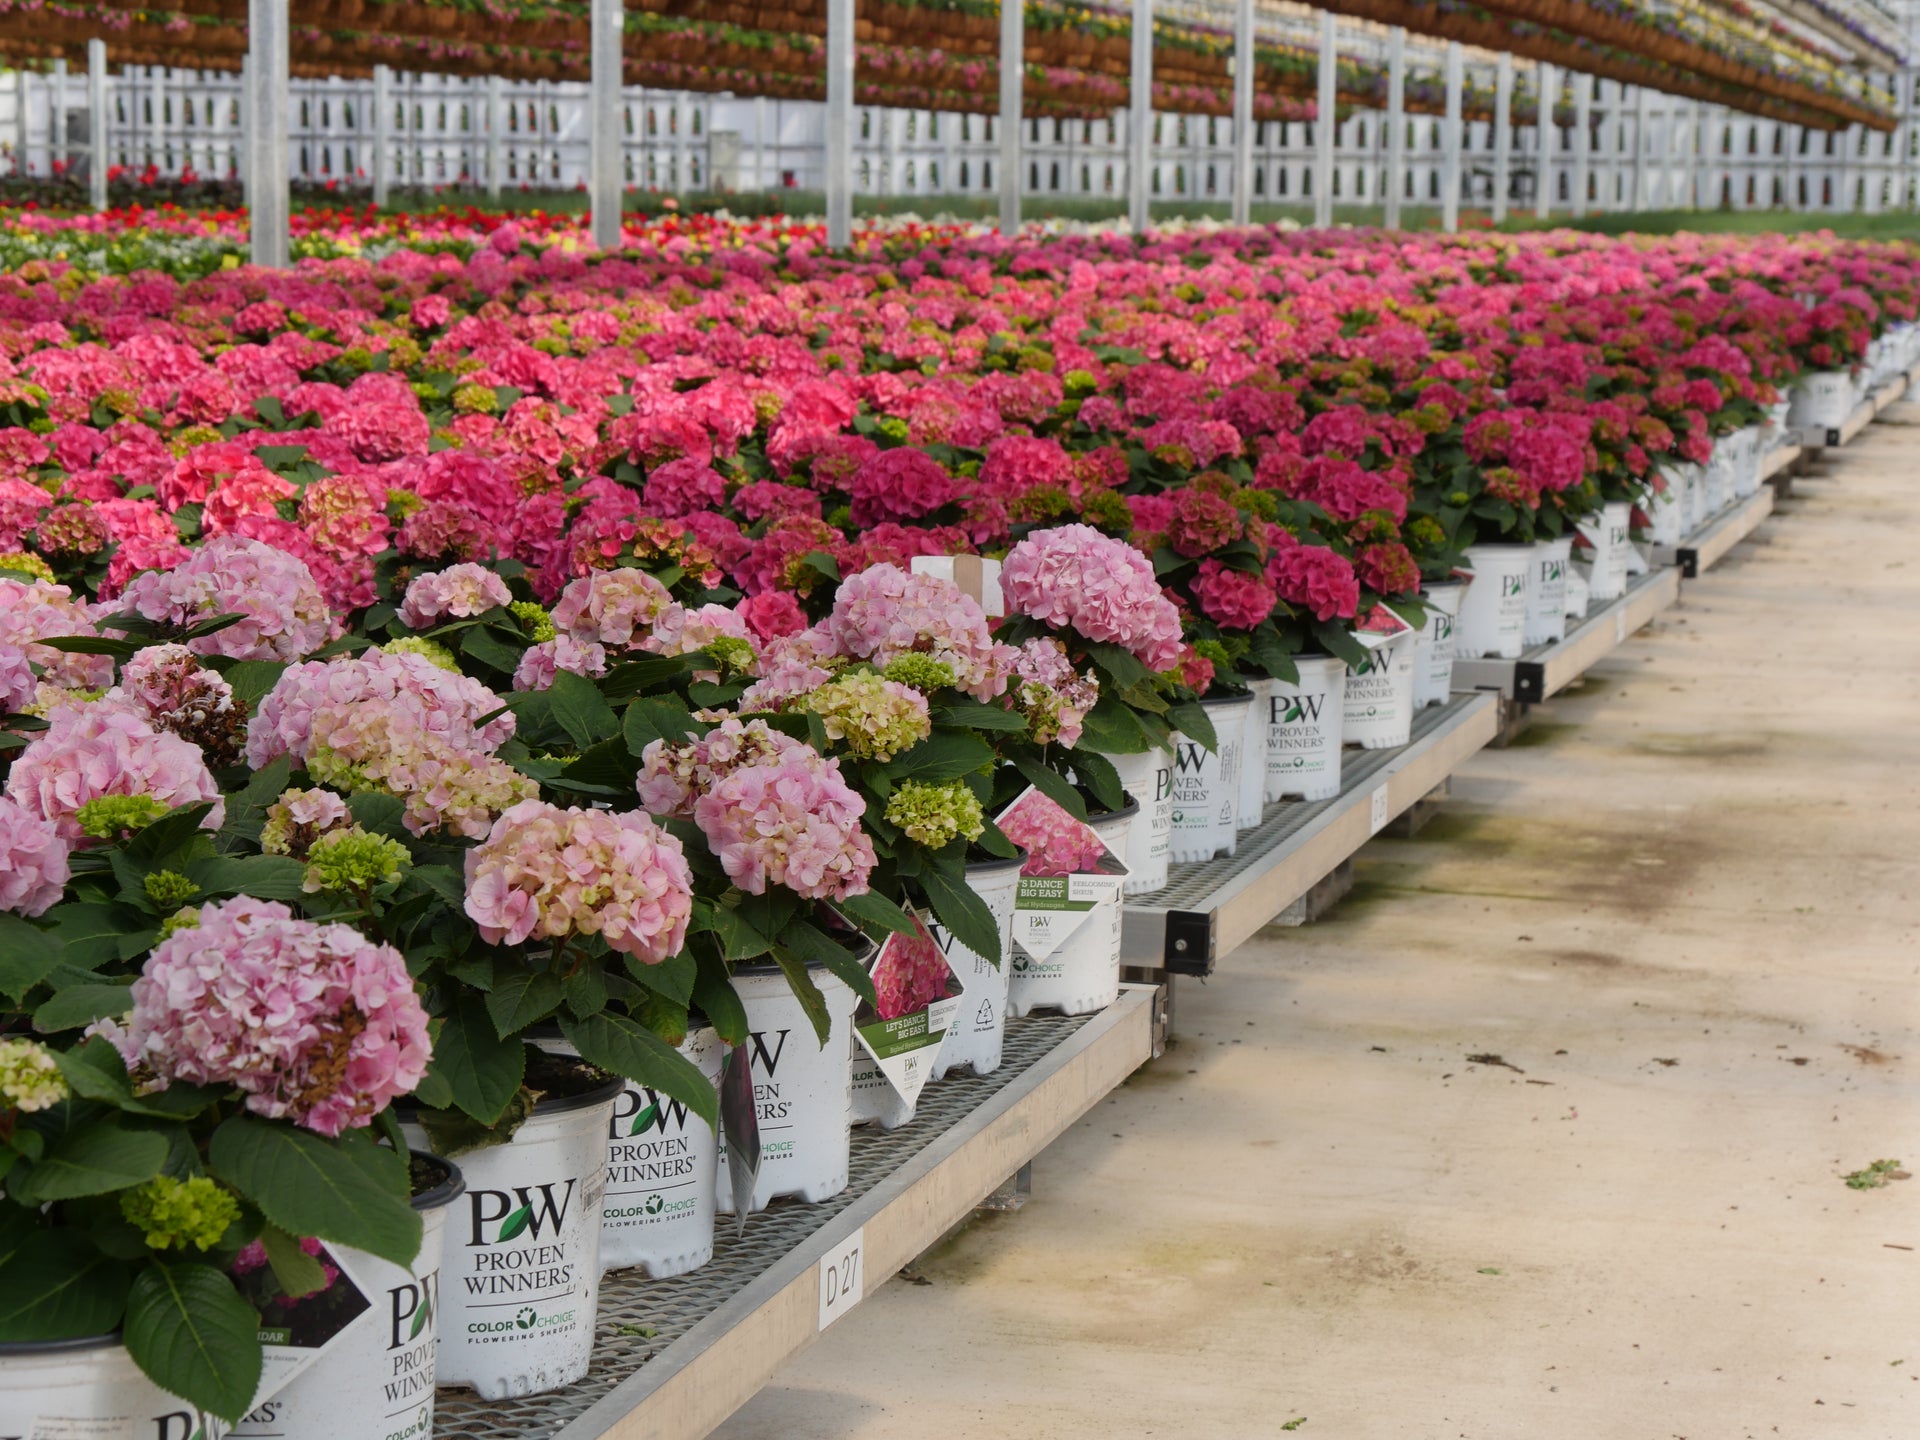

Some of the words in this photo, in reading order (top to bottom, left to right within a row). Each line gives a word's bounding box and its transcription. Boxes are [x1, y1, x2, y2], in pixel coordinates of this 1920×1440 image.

[1346, 677, 1390, 689] PROVEN
[1269, 693, 1326, 724] PW
[1272, 726, 1320, 737] PROVEN
[1267, 738, 1324, 749] WINNERS
[1176, 742, 1208, 774] W
[1176, 777, 1203, 788] VEN
[1173, 790, 1206, 801] NERS
[1030, 879, 1064, 888] DANCE
[1020, 889, 1037, 897] BIG
[1039, 889, 1063, 898] EASY
[1030, 916, 1052, 927] PW
[1029, 964, 1063, 972] CHOICE
[750, 1029, 791, 1078] W
[609, 1087, 688, 1139] PW
[610, 1137, 688, 1162] PROVEN
[761, 1141, 793, 1153] HOICE
[763, 1152, 793, 1161] HRUBS
[606, 1157, 694, 1183] WINNERS
[464, 1178, 577, 1246] PW
[603, 1206, 643, 1218] COLOR
[664, 1198, 696, 1213] CHOICE
[603, 1217, 661, 1228] FLOWERING
[666, 1210, 695, 1221] SHRUBS
[474, 1243, 565, 1271] PROVEN
[464, 1264, 571, 1295] WINNERS
[827, 1265, 838, 1307] D
[841, 1248, 858, 1296] 27
[467, 1321, 514, 1333] COLOR
[536, 1310, 574, 1328] CHOICE
[468, 1333, 534, 1344] FLOWERING
[384, 1363, 434, 1403] WINNE
